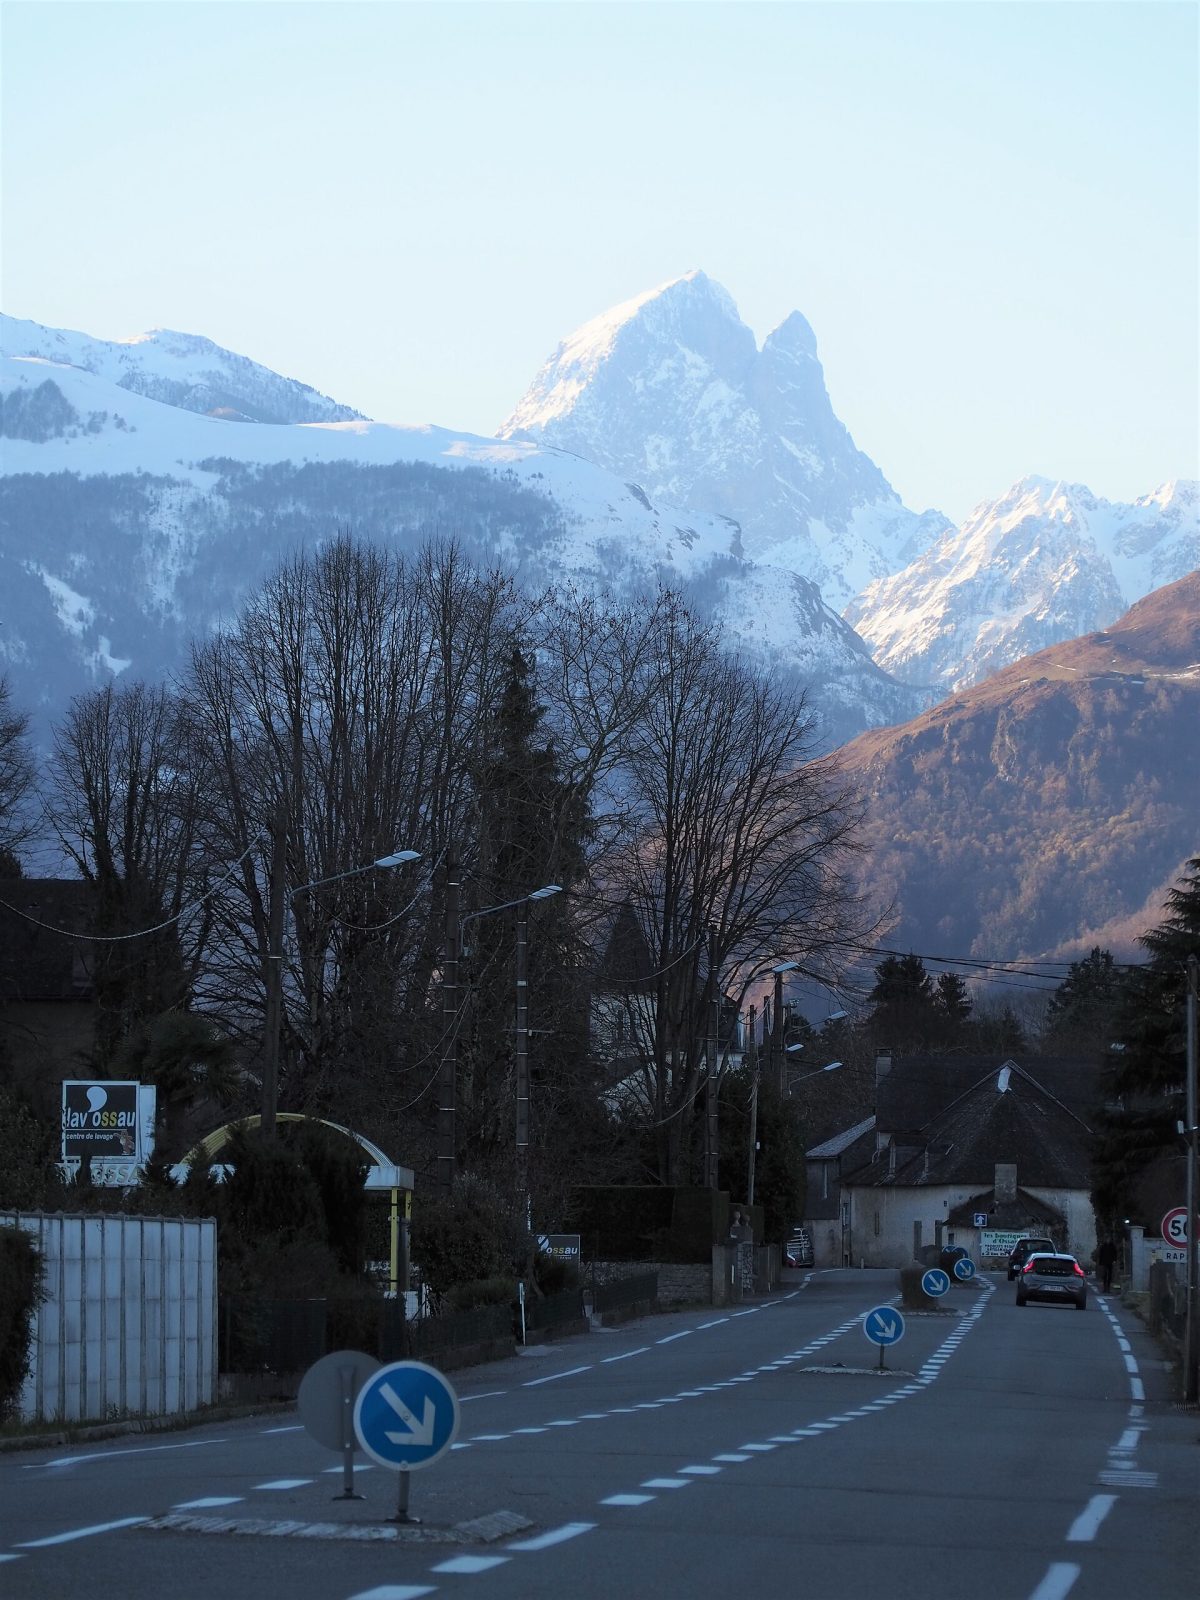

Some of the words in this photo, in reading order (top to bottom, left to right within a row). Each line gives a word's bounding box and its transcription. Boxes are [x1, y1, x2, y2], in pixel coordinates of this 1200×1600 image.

[92, 1111, 136, 1127] ossau
[94, 1133, 114, 1142] lavage
[1166, 1252, 1186, 1260] RAP
